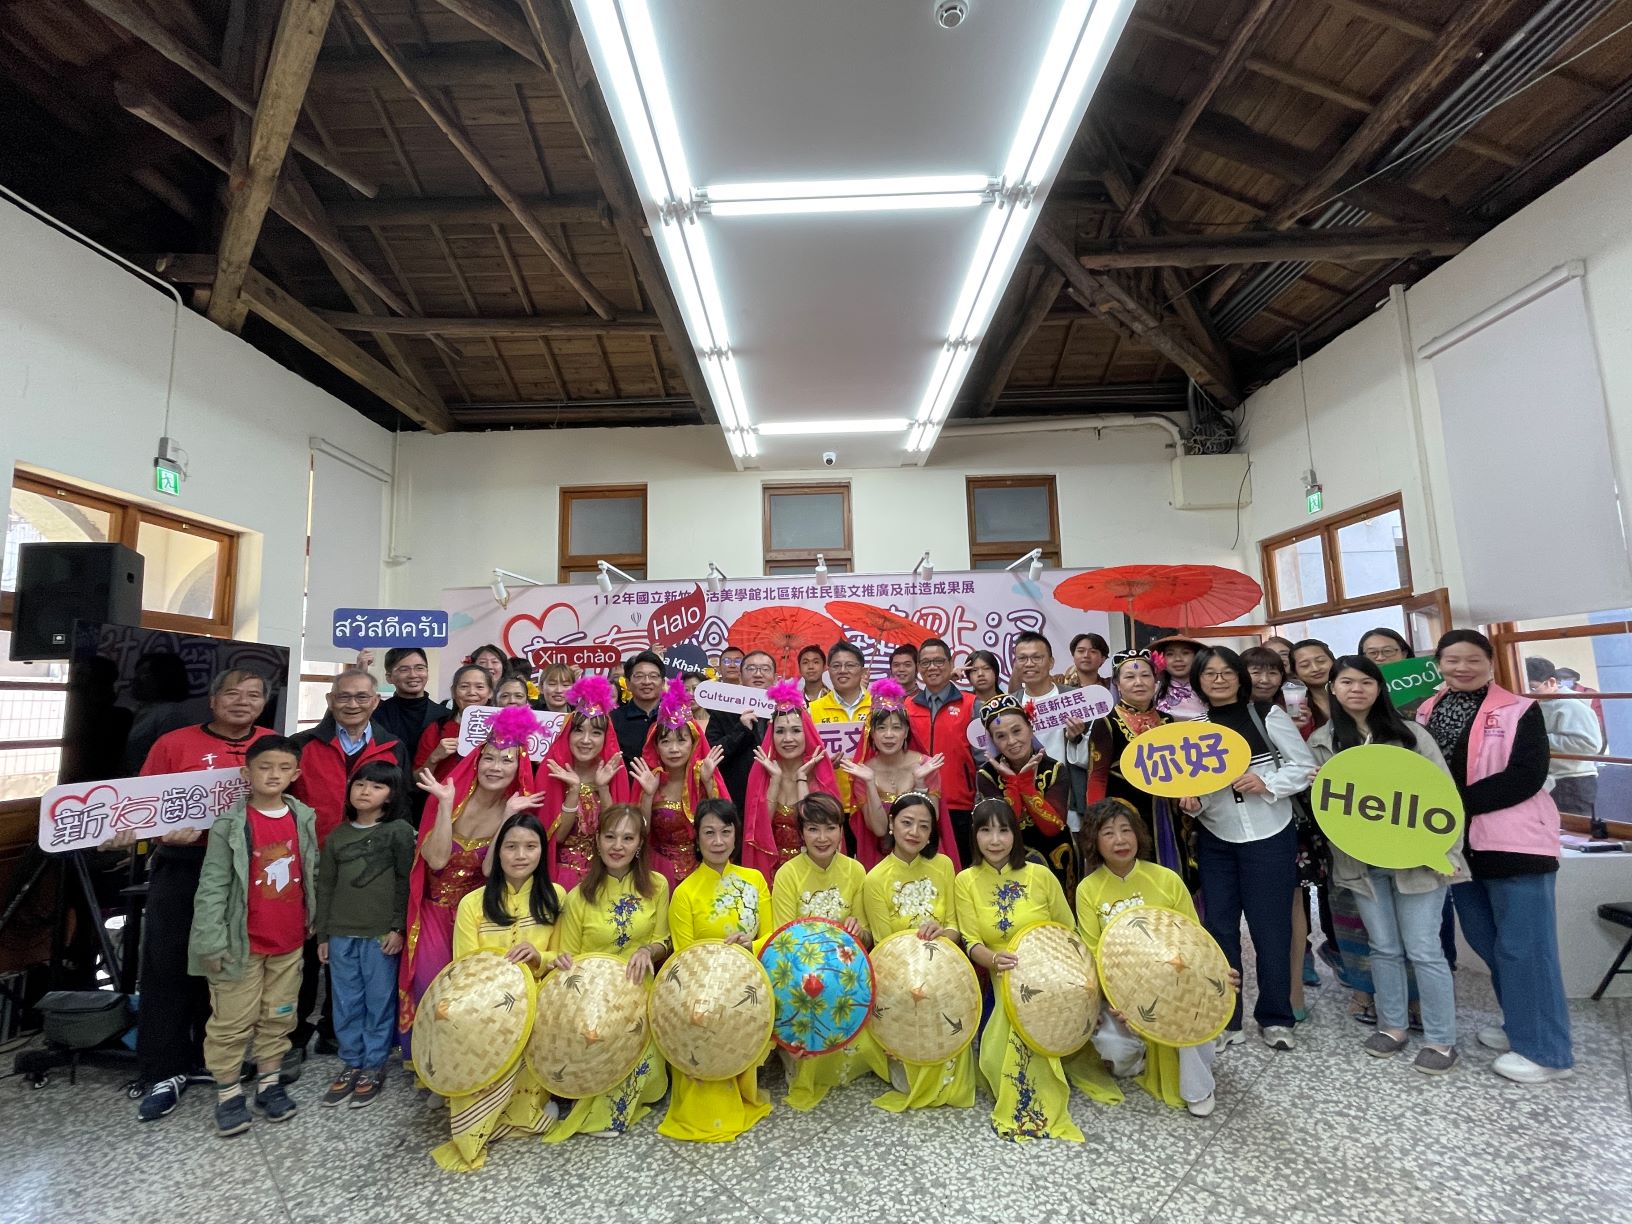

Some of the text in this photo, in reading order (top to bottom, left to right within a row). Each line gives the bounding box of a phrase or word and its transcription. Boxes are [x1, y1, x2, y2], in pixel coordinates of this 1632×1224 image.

[335, 614, 447, 638] สวัสดีครับ
[652, 605, 701, 640] Halo
[538, 648, 617, 665] Xin chào
[698, 689, 776, 711] Cultural Dive
[1035, 692, 1087, 716] 區新住民
[818, 727, 862, 764] 元文
[1133, 732, 1230, 786] 你好
[1318, 778, 1457, 836] Hello
